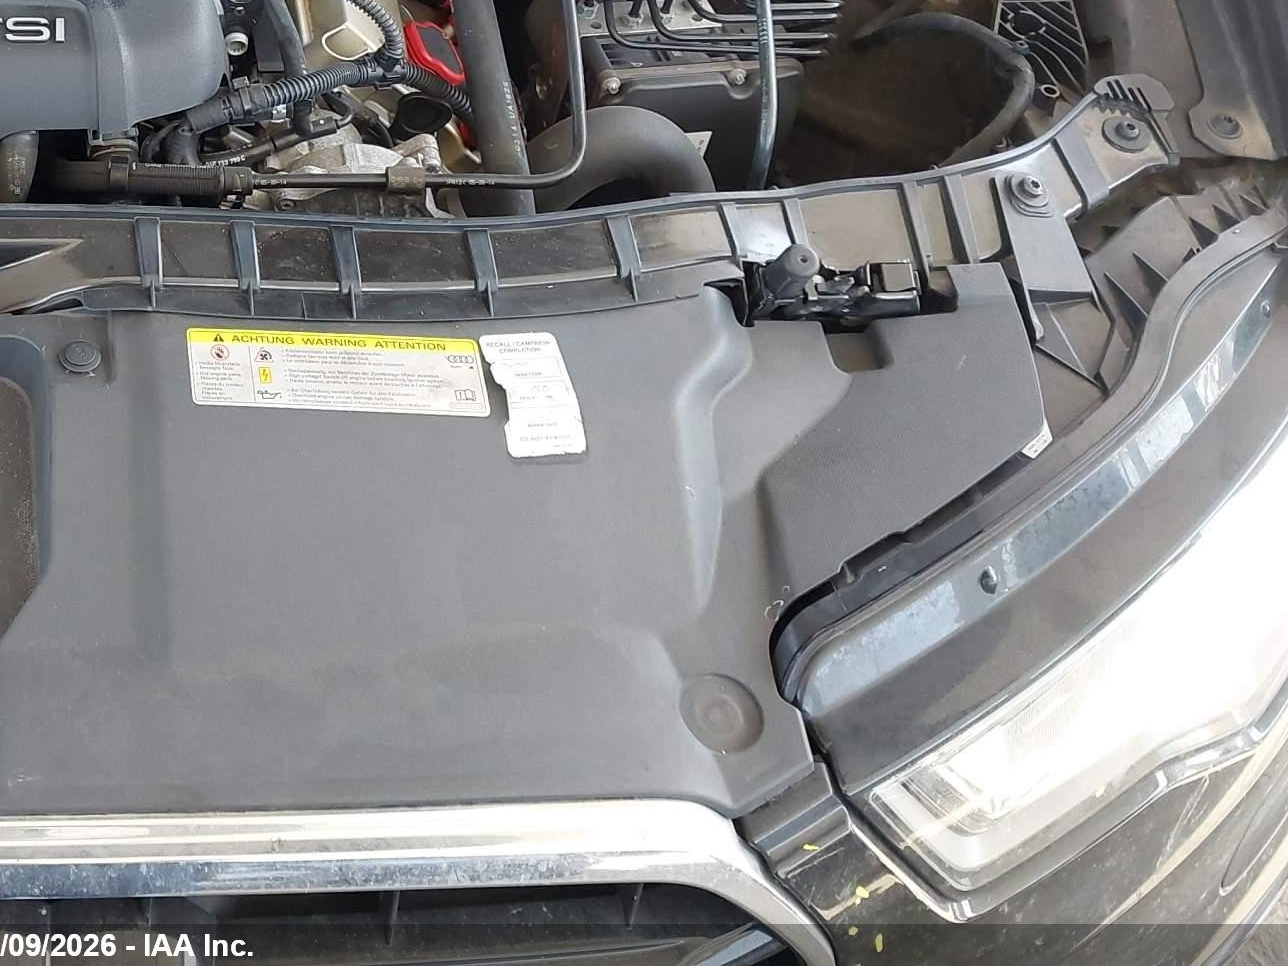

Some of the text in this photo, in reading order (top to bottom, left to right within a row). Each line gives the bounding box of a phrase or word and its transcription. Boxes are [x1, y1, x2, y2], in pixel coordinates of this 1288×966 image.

[231, 335, 446, 351] ACHTUNG WARNING ATTENTION
